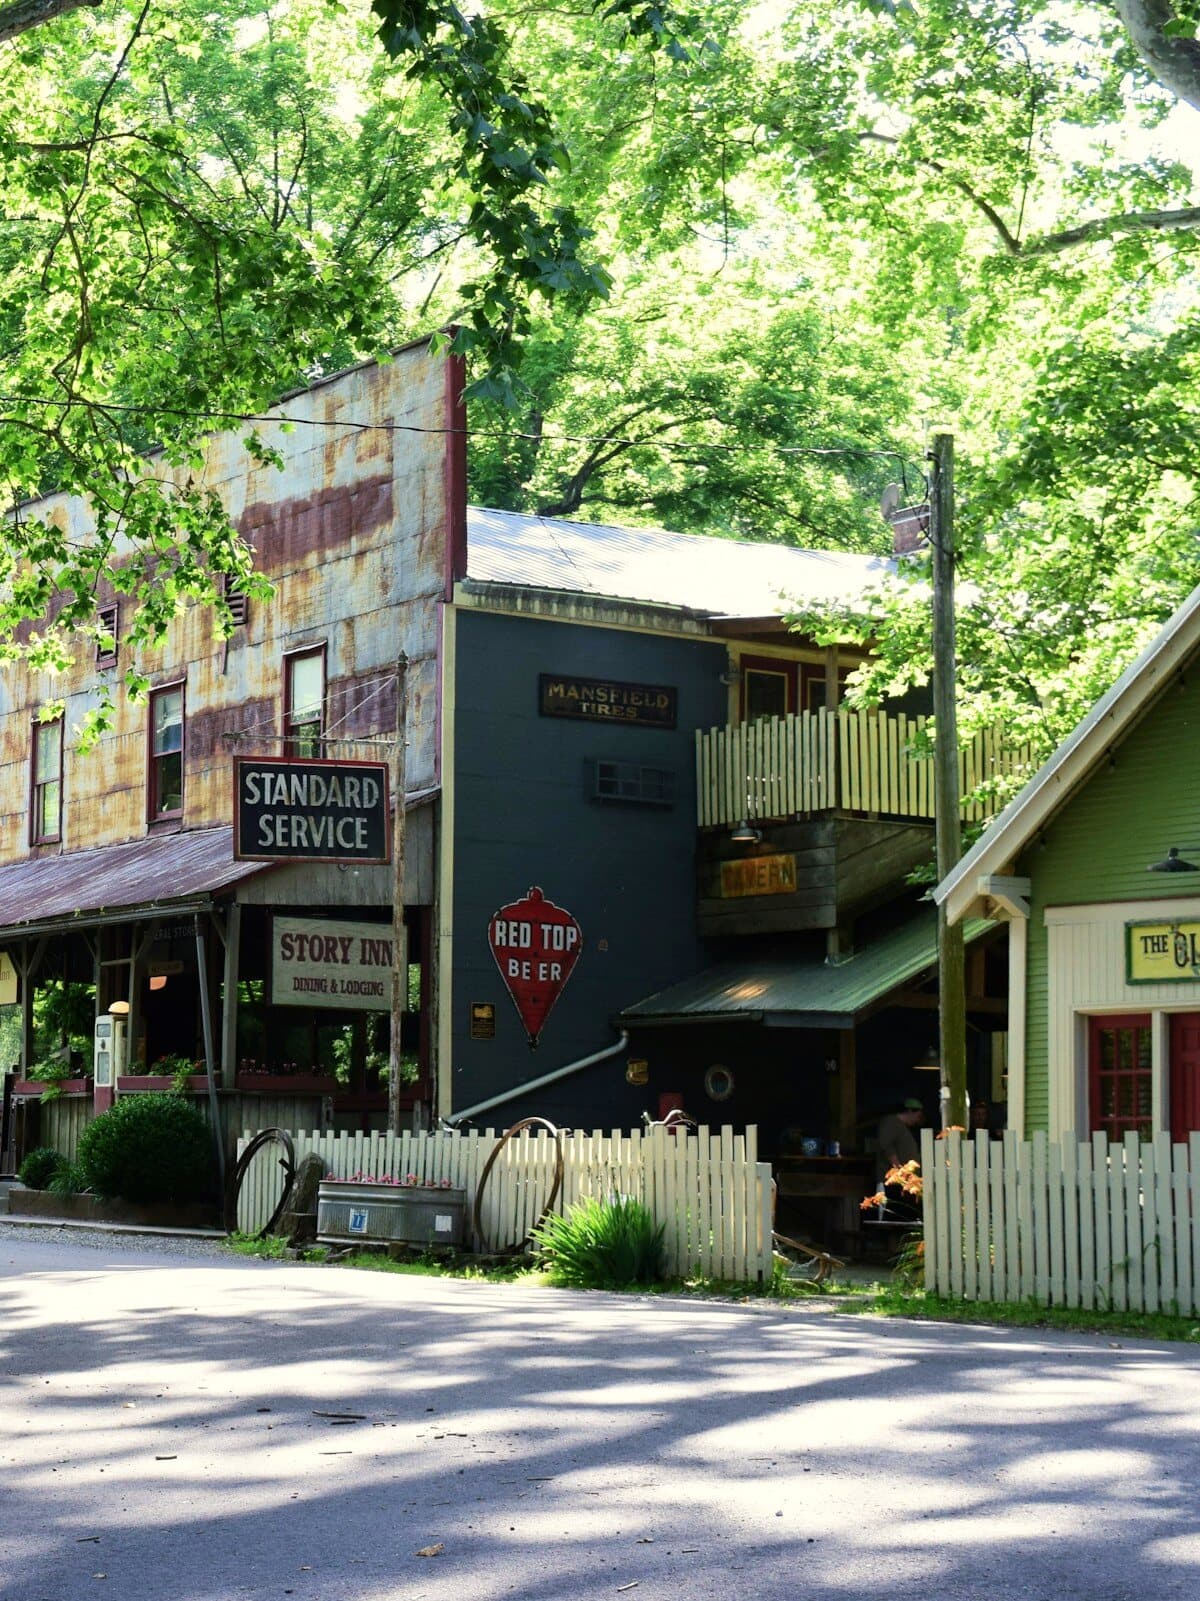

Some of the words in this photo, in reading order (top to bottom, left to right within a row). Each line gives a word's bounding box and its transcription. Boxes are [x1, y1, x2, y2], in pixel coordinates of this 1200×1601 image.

[548, 682, 669, 709] MANSFIELD
[579, 702, 638, 719] TIRES
[245, 772, 379, 809] STANDARD
[258, 814, 368, 849] SERVICE
[495, 920, 531, 948] RED
[541, 924, 577, 951] TOP
[1140, 934, 1169, 954] THE
[281, 933, 354, 964] STORY
[360, 938, 393, 967] INN
[508, 958, 561, 981] BEER
[293, 977, 327, 993] DINING
[330, 979, 338, 993] &
[341, 980, 384, 996] LODGING
